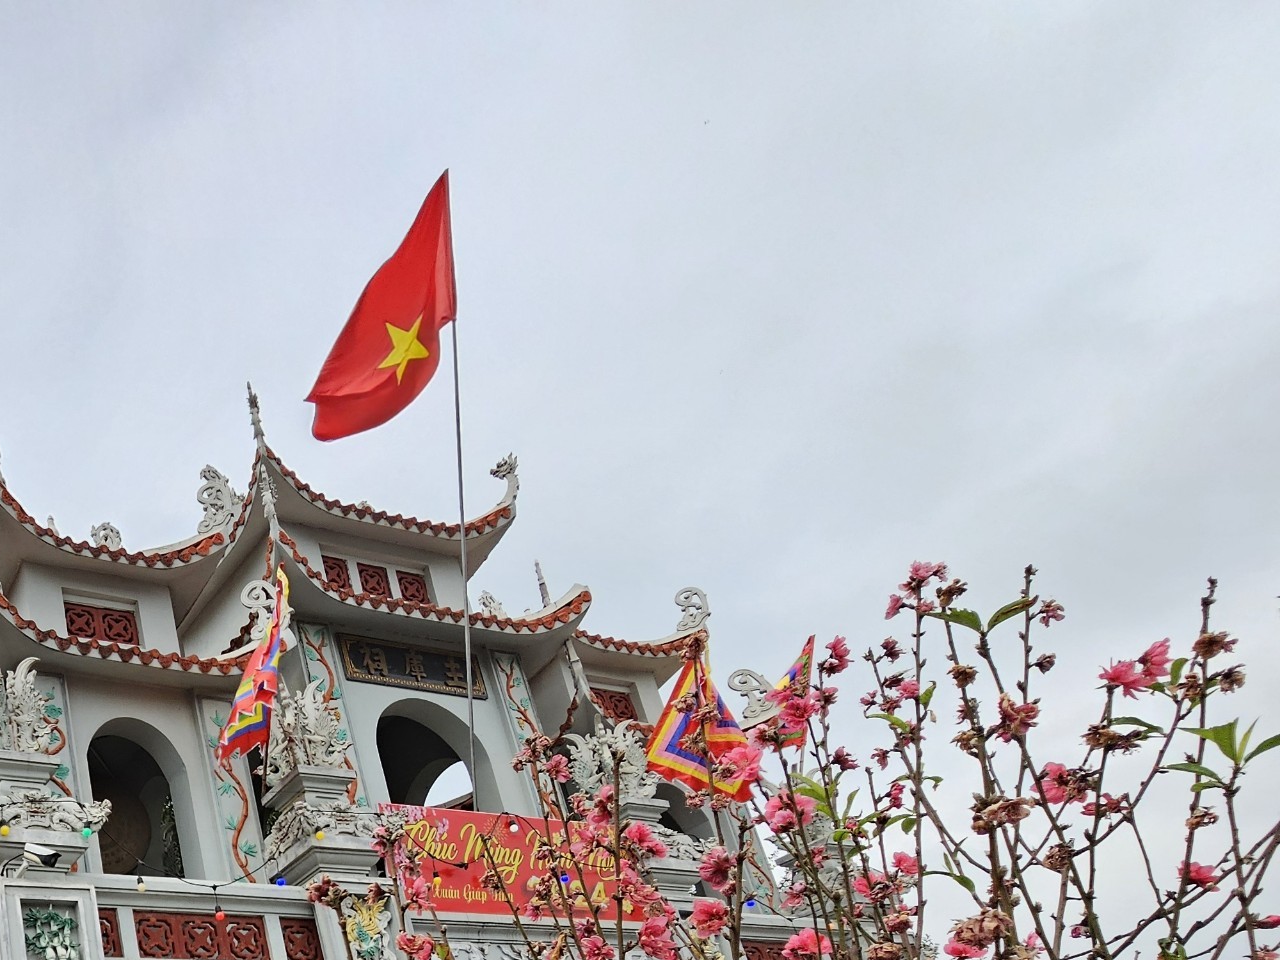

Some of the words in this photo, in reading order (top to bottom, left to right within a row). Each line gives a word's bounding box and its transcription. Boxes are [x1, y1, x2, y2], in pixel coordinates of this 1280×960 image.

[404, 819, 459, 862] Chúc
[459, 822, 524, 885] Mừng
[463, 883, 488, 904] Giáp
